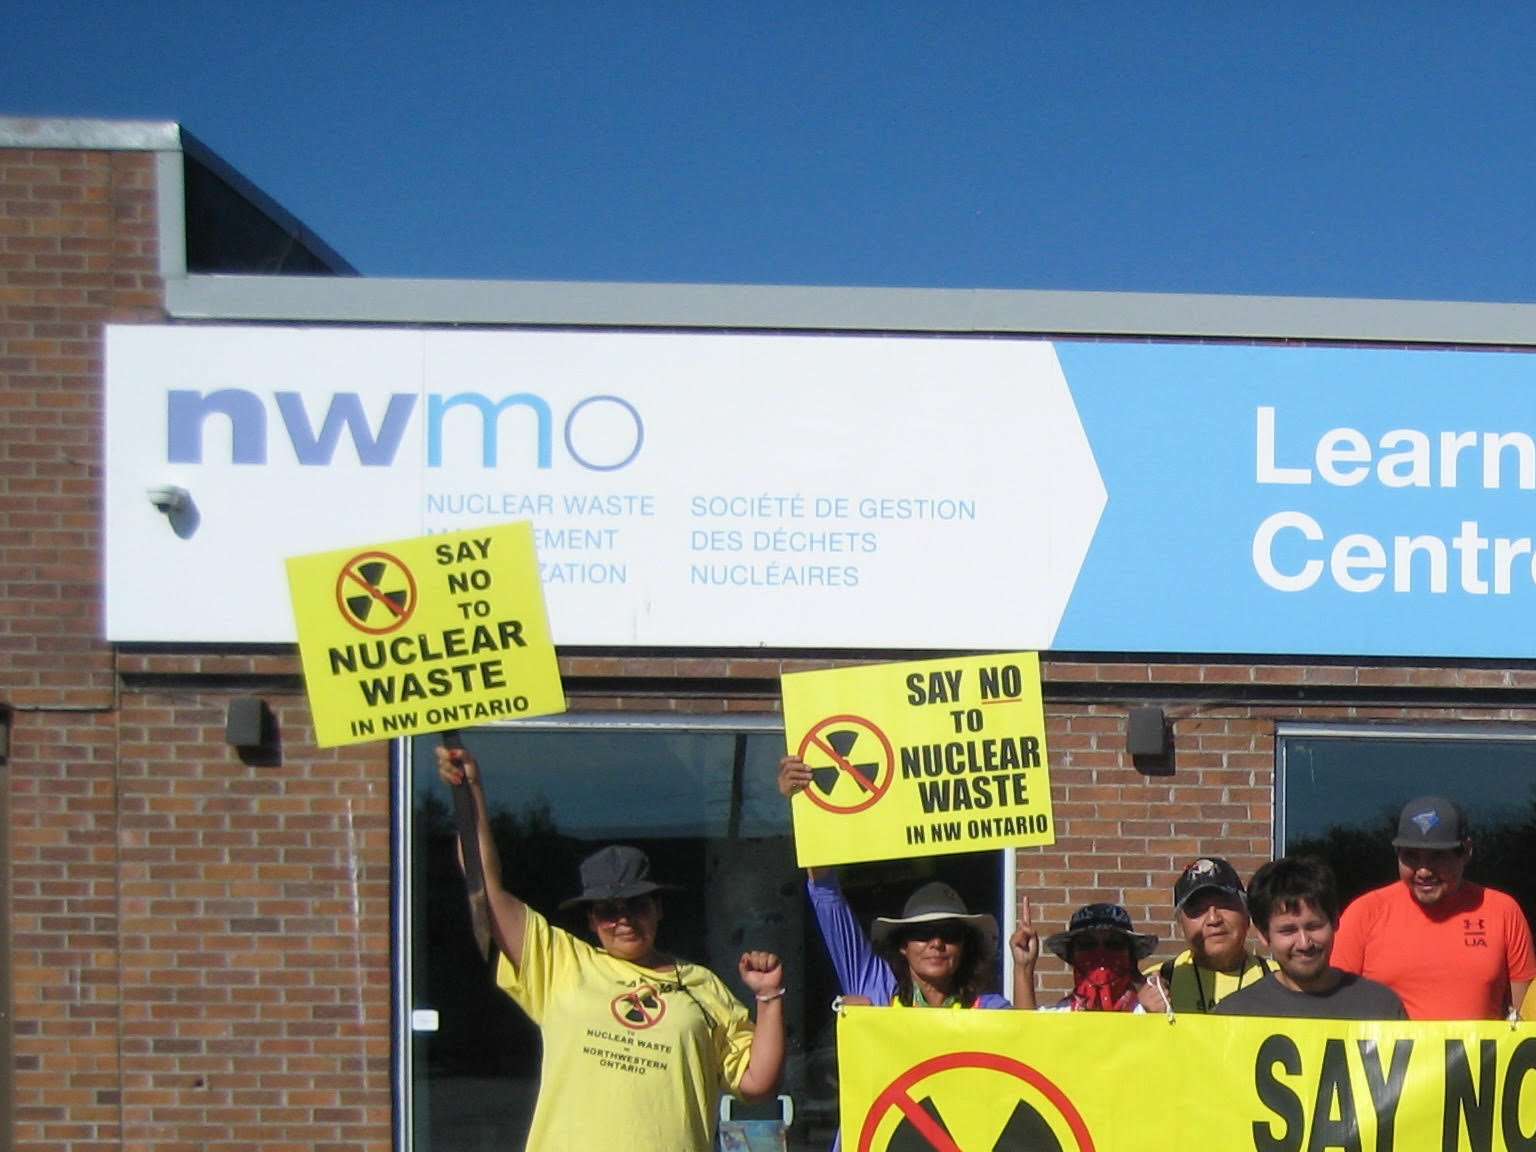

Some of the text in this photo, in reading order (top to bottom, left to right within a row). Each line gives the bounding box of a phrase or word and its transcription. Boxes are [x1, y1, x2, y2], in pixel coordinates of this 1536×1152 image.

[167, 388, 644, 472] nwmo
[1256, 406, 1536, 490] Learn
[427, 494, 656, 516] NUCLEAR WASTE
[691, 493, 976, 520] SOCIÉTÉ DE GESTION
[436, 537, 492, 566] SAY
[691, 527, 878, 553] DES DÉCHETS
[448, 569, 492, 594] NO
[691, 561, 859, 587] NUCLÉAIRES
[458, 600, 490, 620] TO
[328, 620, 527, 675] NUCLEAR
[359, 660, 506, 707] WASTE
[906, 665, 1022, 706] SAY NO
[351, 696, 529, 736] IN NW ONTARIO
[950, 708, 984, 733] TO
[900, 736, 1041, 779] NUCLEAR
[918, 773, 1029, 814] WASTE
[906, 814, 1048, 845] IN NW ONTARIO
[587, 1029, 672, 1054] NUCLEAR WASTE
[583, 1046, 668, 1071] NORTHWESTERN
[600, 1059, 646, 1075] ONTARIO
